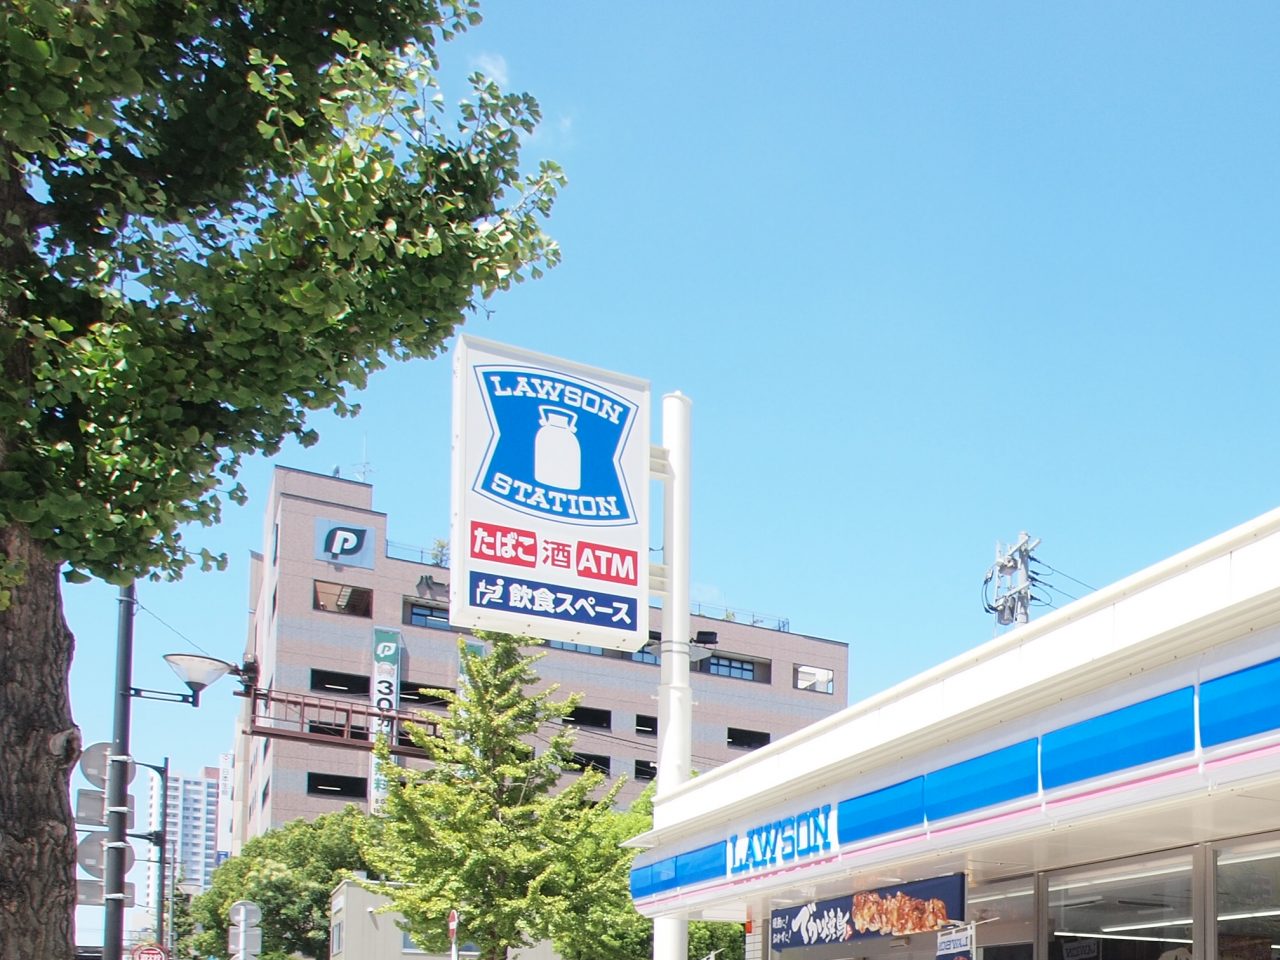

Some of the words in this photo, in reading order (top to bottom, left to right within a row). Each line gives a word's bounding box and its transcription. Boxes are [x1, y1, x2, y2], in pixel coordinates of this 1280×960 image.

[490, 375, 624, 425] LAWSON
[491, 472, 620, 516] STATION
[474, 528, 536, 563] たばこ
[543, 539, 571, 569] 酒
[578, 554, 635, 580] ATM
[509, 583, 632, 624] 飲食スペース
[730, 804, 832, 875] LAWSON
